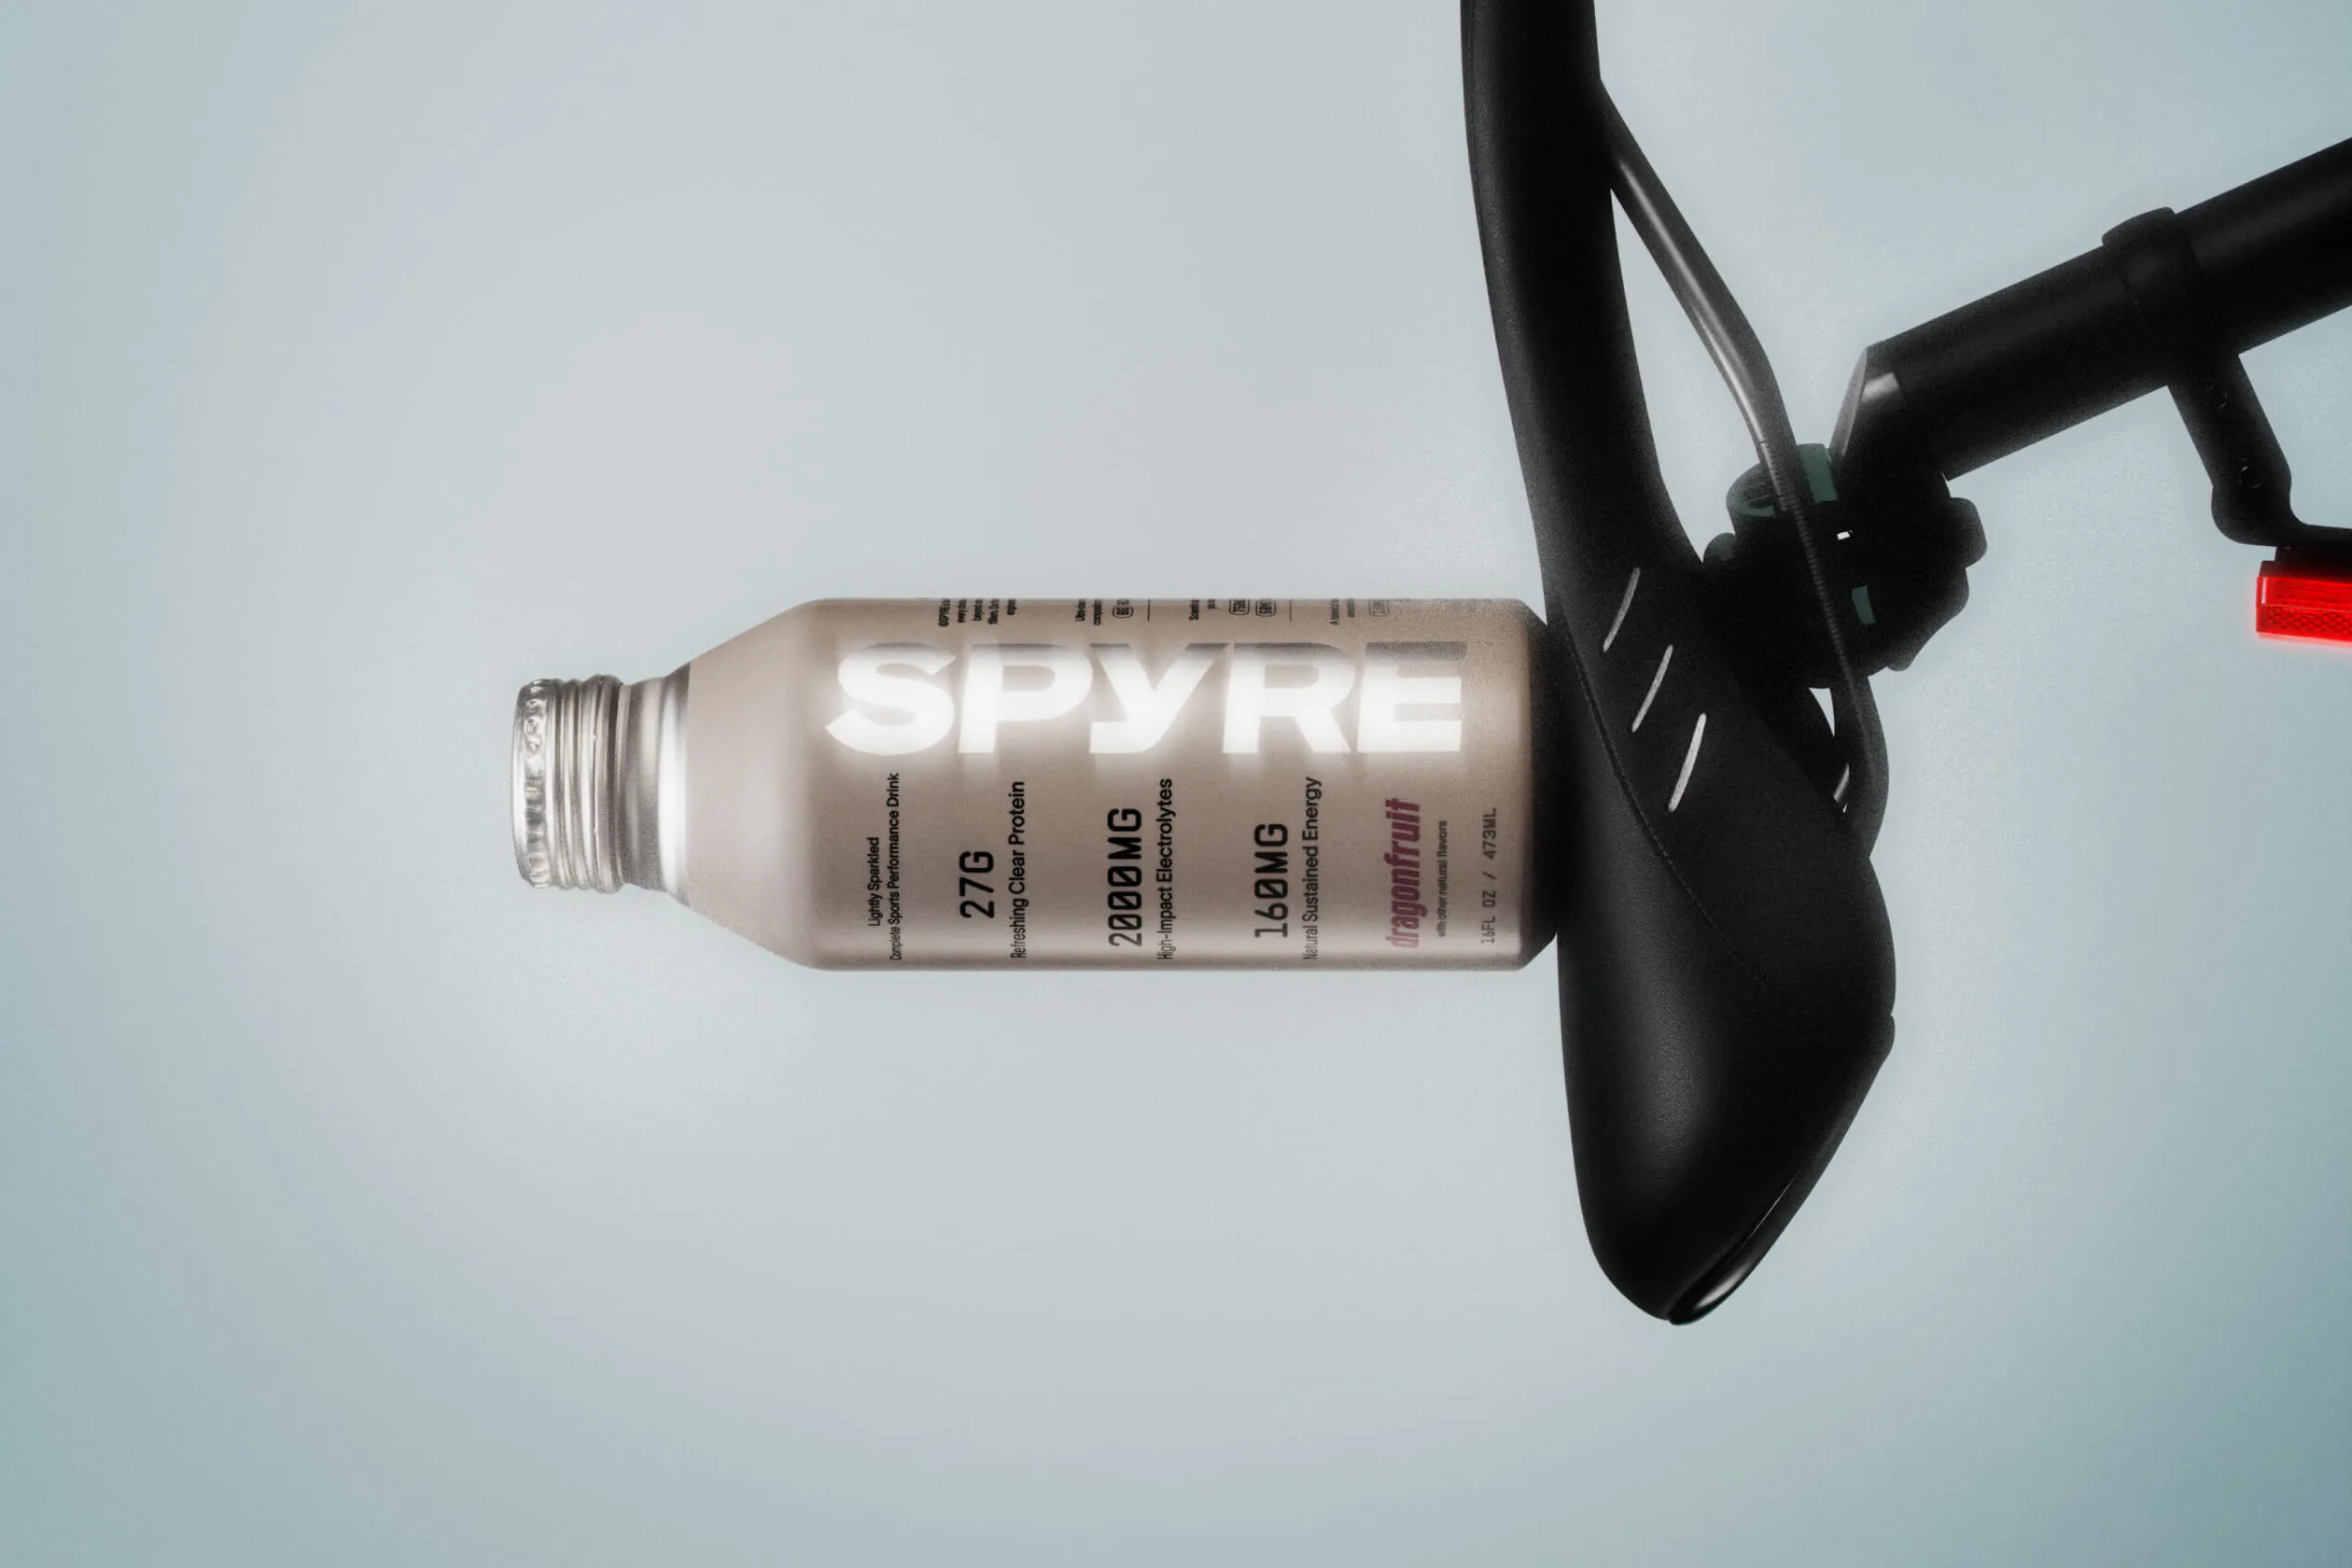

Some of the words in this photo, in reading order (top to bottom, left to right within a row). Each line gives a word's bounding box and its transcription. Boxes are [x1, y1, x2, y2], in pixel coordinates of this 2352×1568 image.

[825, 642, 1466, 755] SPYRE
[887, 773, 900, 807] Drink
[1008, 781, 1025, 845] Protein
[1303, 777, 1322, 841] Energy
[887, 810, 900, 889] Performance
[1156, 778, 1175, 882] Electrolytes
[1437, 820, 1448, 857] flavors
[1482, 807, 1497, 860] 473ML
[866, 837, 882, 891] Sparkled
[959, 851, 994, 918] 27G
[1009, 850, 1025, 894] Clear
[1108, 808, 1142, 946] 2000MG
[1254, 823, 1288, 938] 160MG
[1303, 846, 1318, 922] Sustained
[1384, 798, 1428, 948] dragonfruit
[1437, 860, 1447, 895] natural
[867, 893, 883, 927] Lightly
[888, 891, 903, 925] Sports
[1157, 887, 1176, 959] High-Impact
[1437, 896, 1447, 919] other
[1482, 890, 1496, 908] OZ
[889, 927, 903, 960] Complete
[1009, 898, 1029, 959] Refreshing
[1303, 925, 1318, 959] Natural
[1437, 921, 1447, 938] with
[1481, 917, 1496, 944] 16FL
